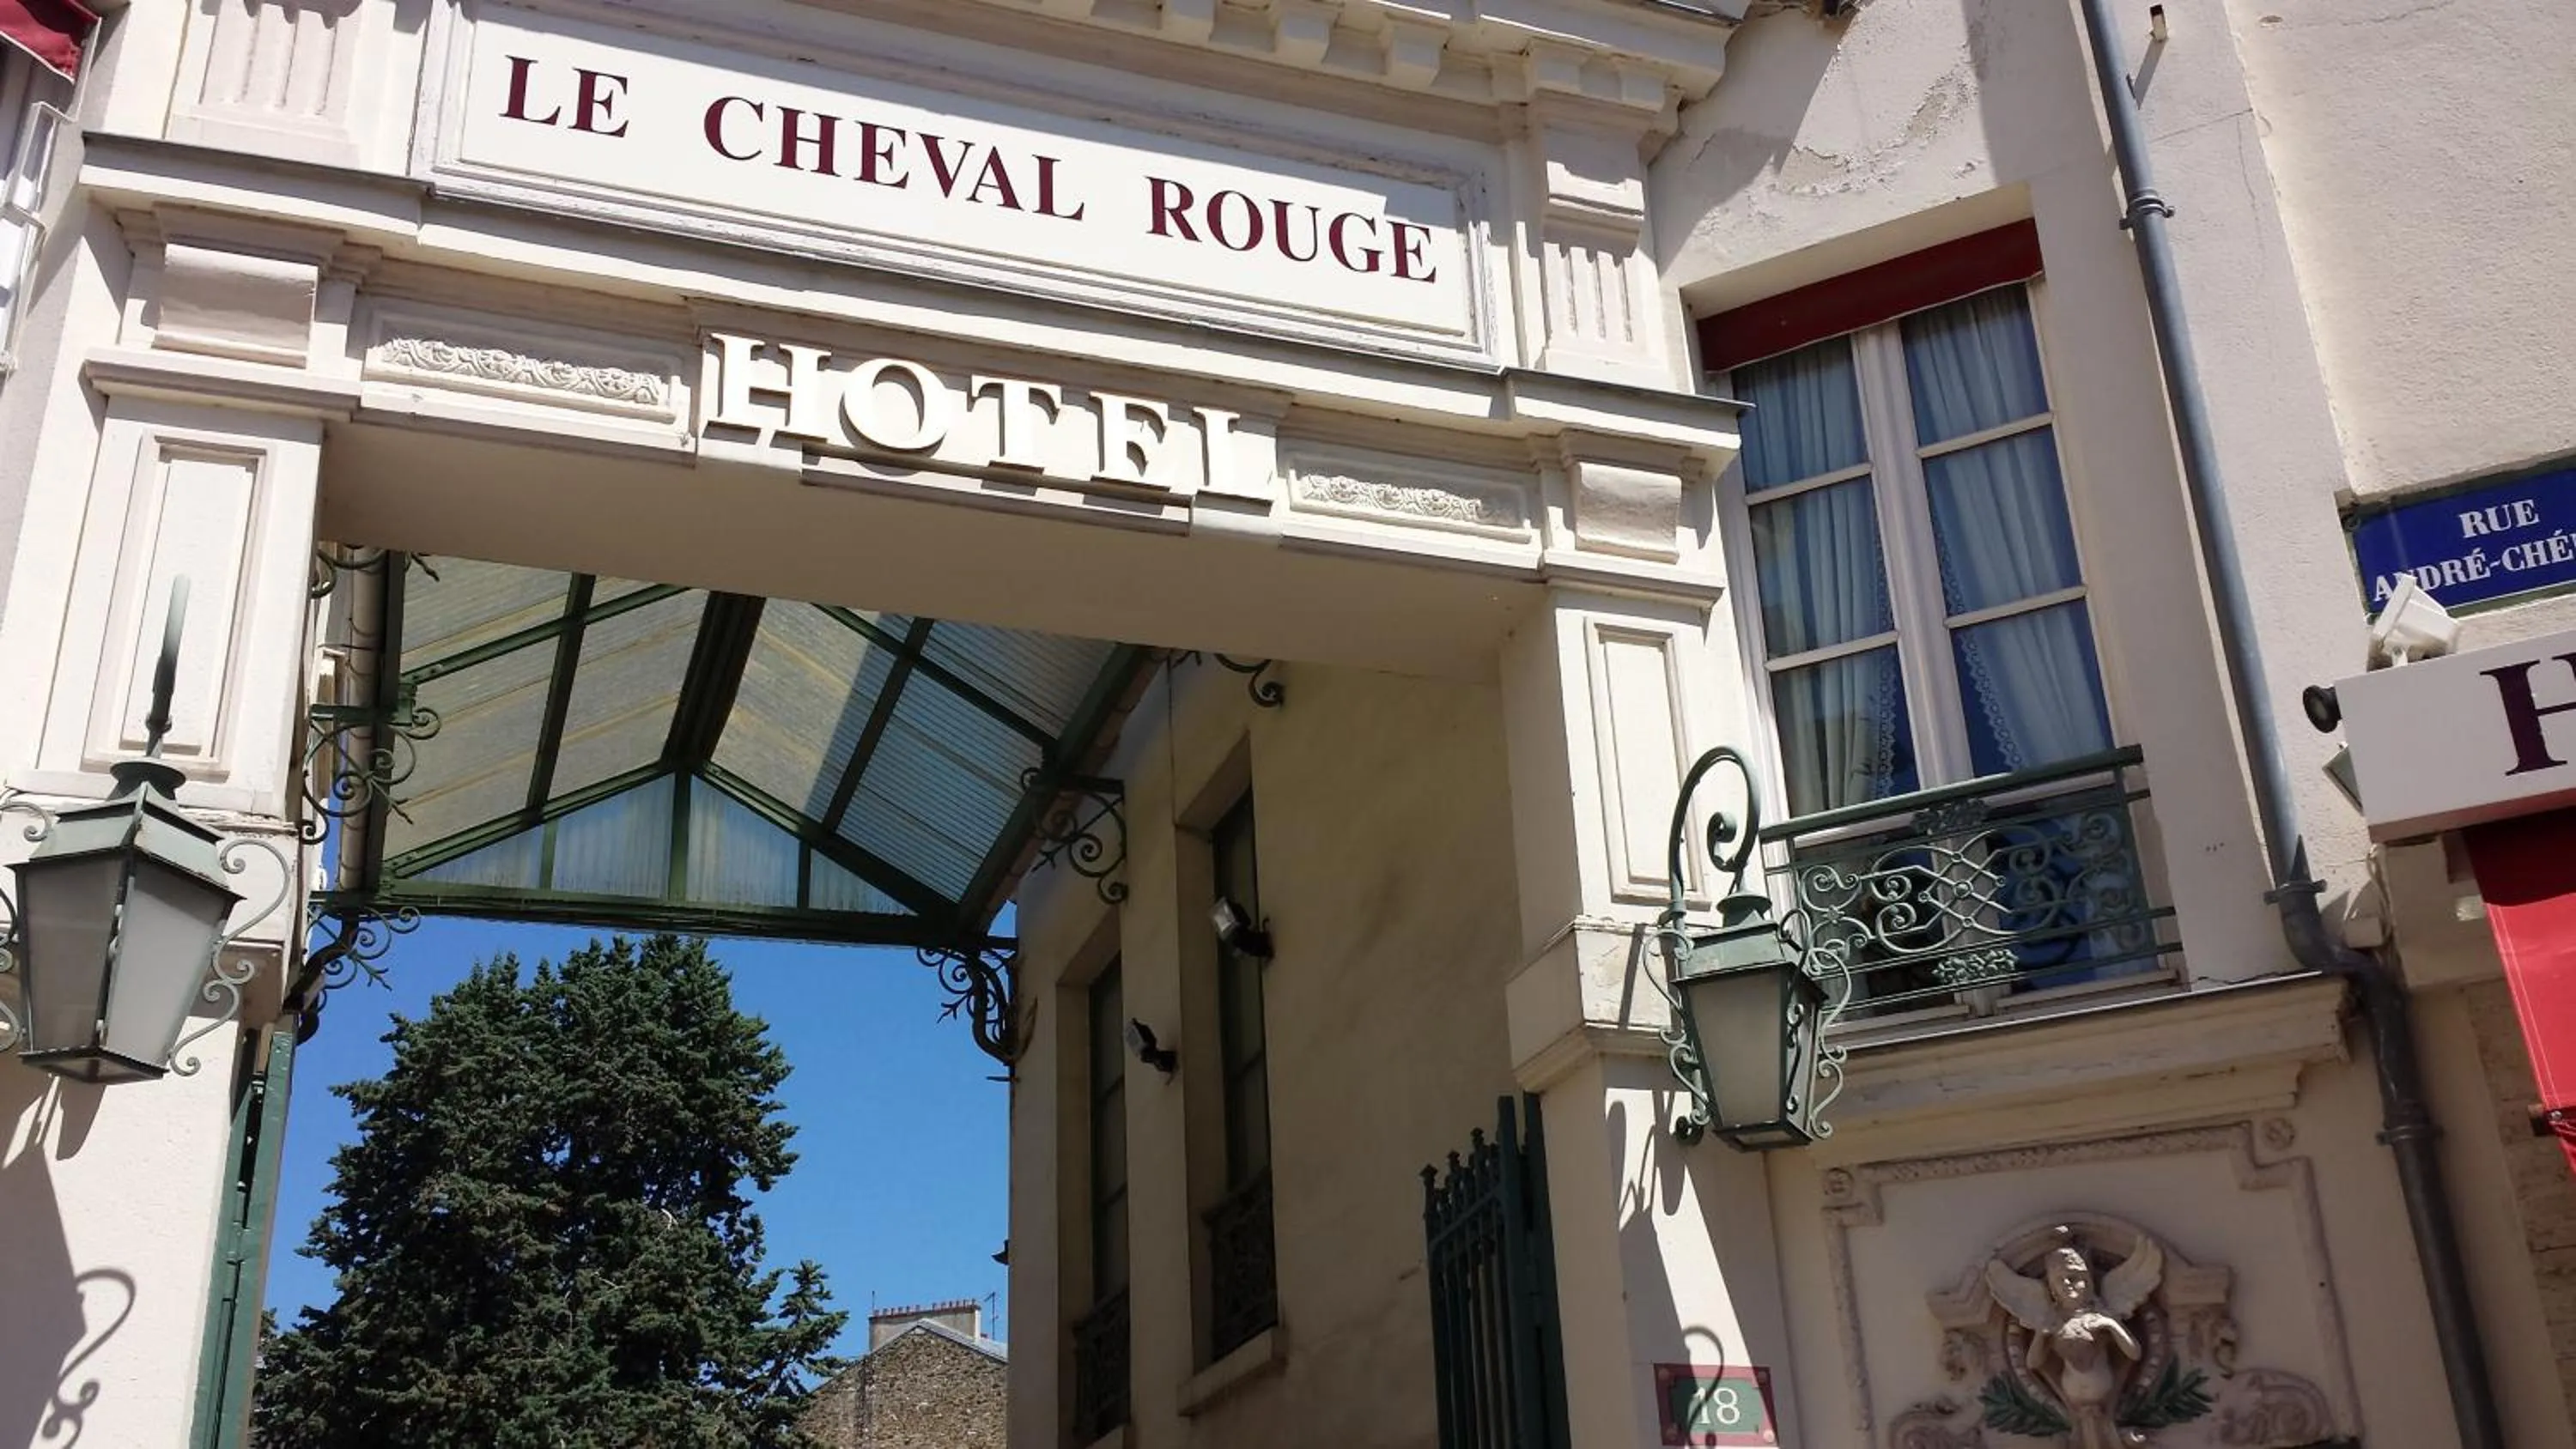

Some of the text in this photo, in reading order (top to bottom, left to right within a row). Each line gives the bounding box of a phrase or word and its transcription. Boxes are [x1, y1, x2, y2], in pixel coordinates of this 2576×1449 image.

[499, 55, 1437, 284] LE CHEVAL ROUGE
[708, 332, 1277, 502] HOTEL
[2458, 499, 2540, 538] RUE
[2373, 530, 2576, 602] ADRÉ-CHÉ
[1693, 1386, 1741, 1425] 18
